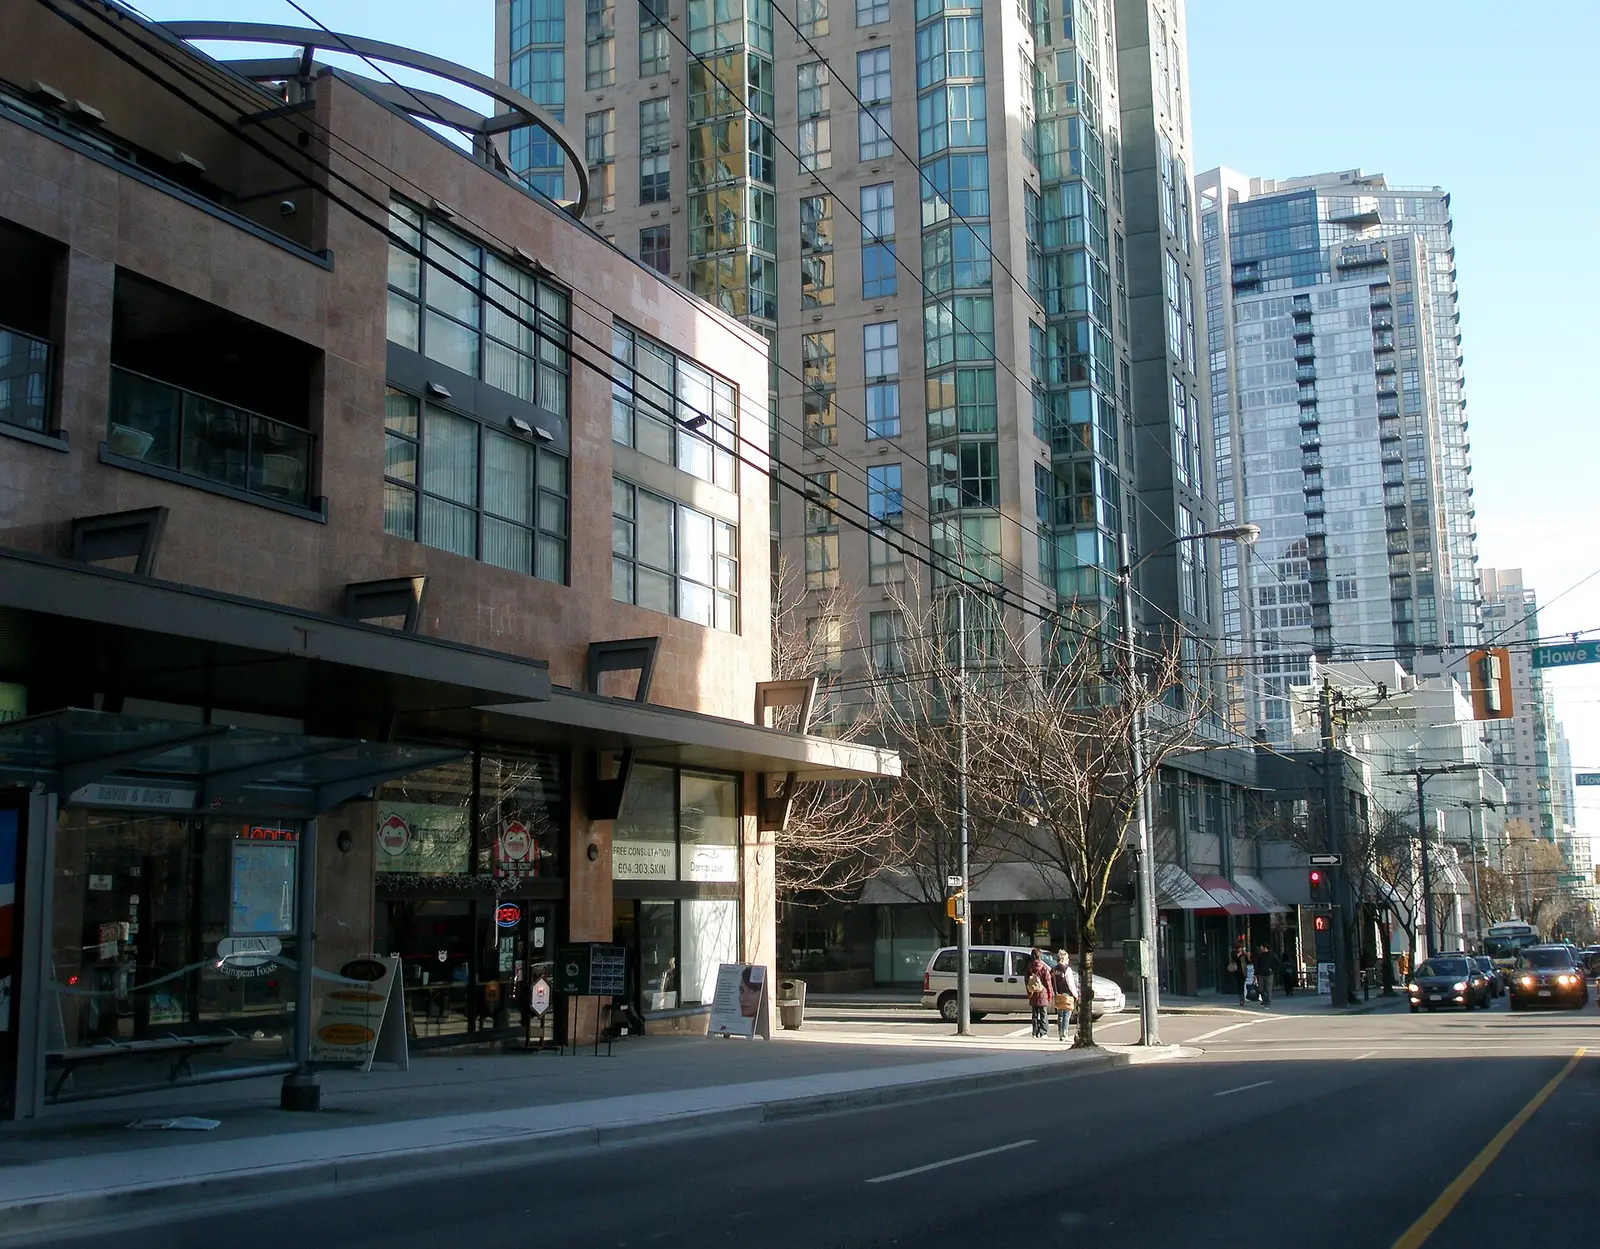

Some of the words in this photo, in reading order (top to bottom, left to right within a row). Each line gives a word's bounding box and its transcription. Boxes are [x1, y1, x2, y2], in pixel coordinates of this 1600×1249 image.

[1539, 649, 1588, 665] Howe
[613, 846, 627, 856] FREE
[629, 847, 671, 858] CONSULTATION
[618, 863, 666, 875] 604.303.SKIN
[497, 908, 521, 922] OPEN
[535, 916, 545, 924] 809
[231, 939, 269, 955] URBAN
[220, 964, 255, 979] European
[256, 962, 278, 976] Foods
